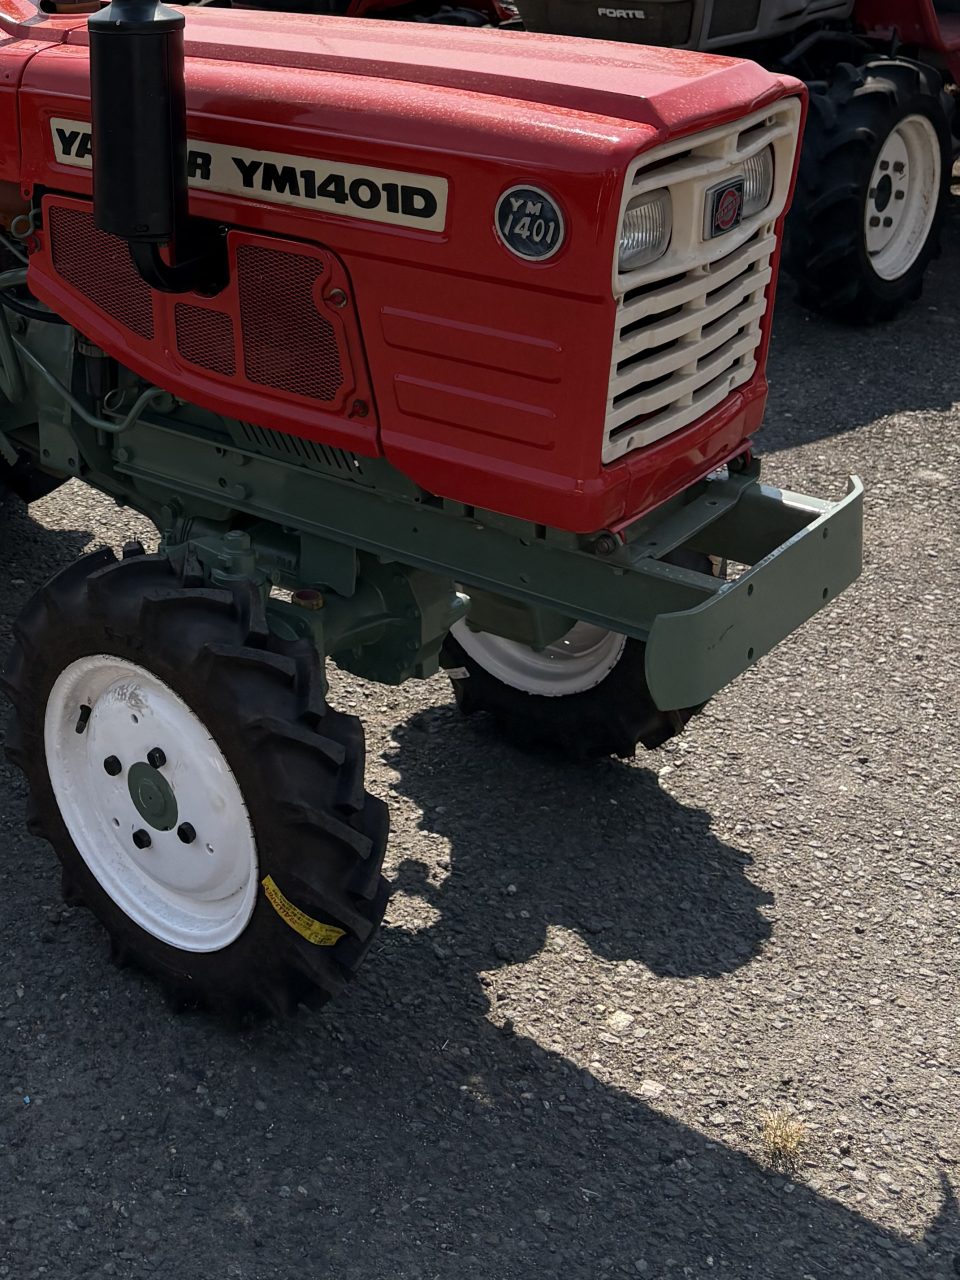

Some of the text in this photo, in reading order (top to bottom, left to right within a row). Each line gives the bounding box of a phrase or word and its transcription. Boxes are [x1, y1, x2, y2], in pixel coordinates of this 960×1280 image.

[598, 7, 645, 19] FORTE
[55, 128, 438, 219] YAR YM1401D
[509, 197, 543, 216] YM
[503, 213, 556, 245] 1401
